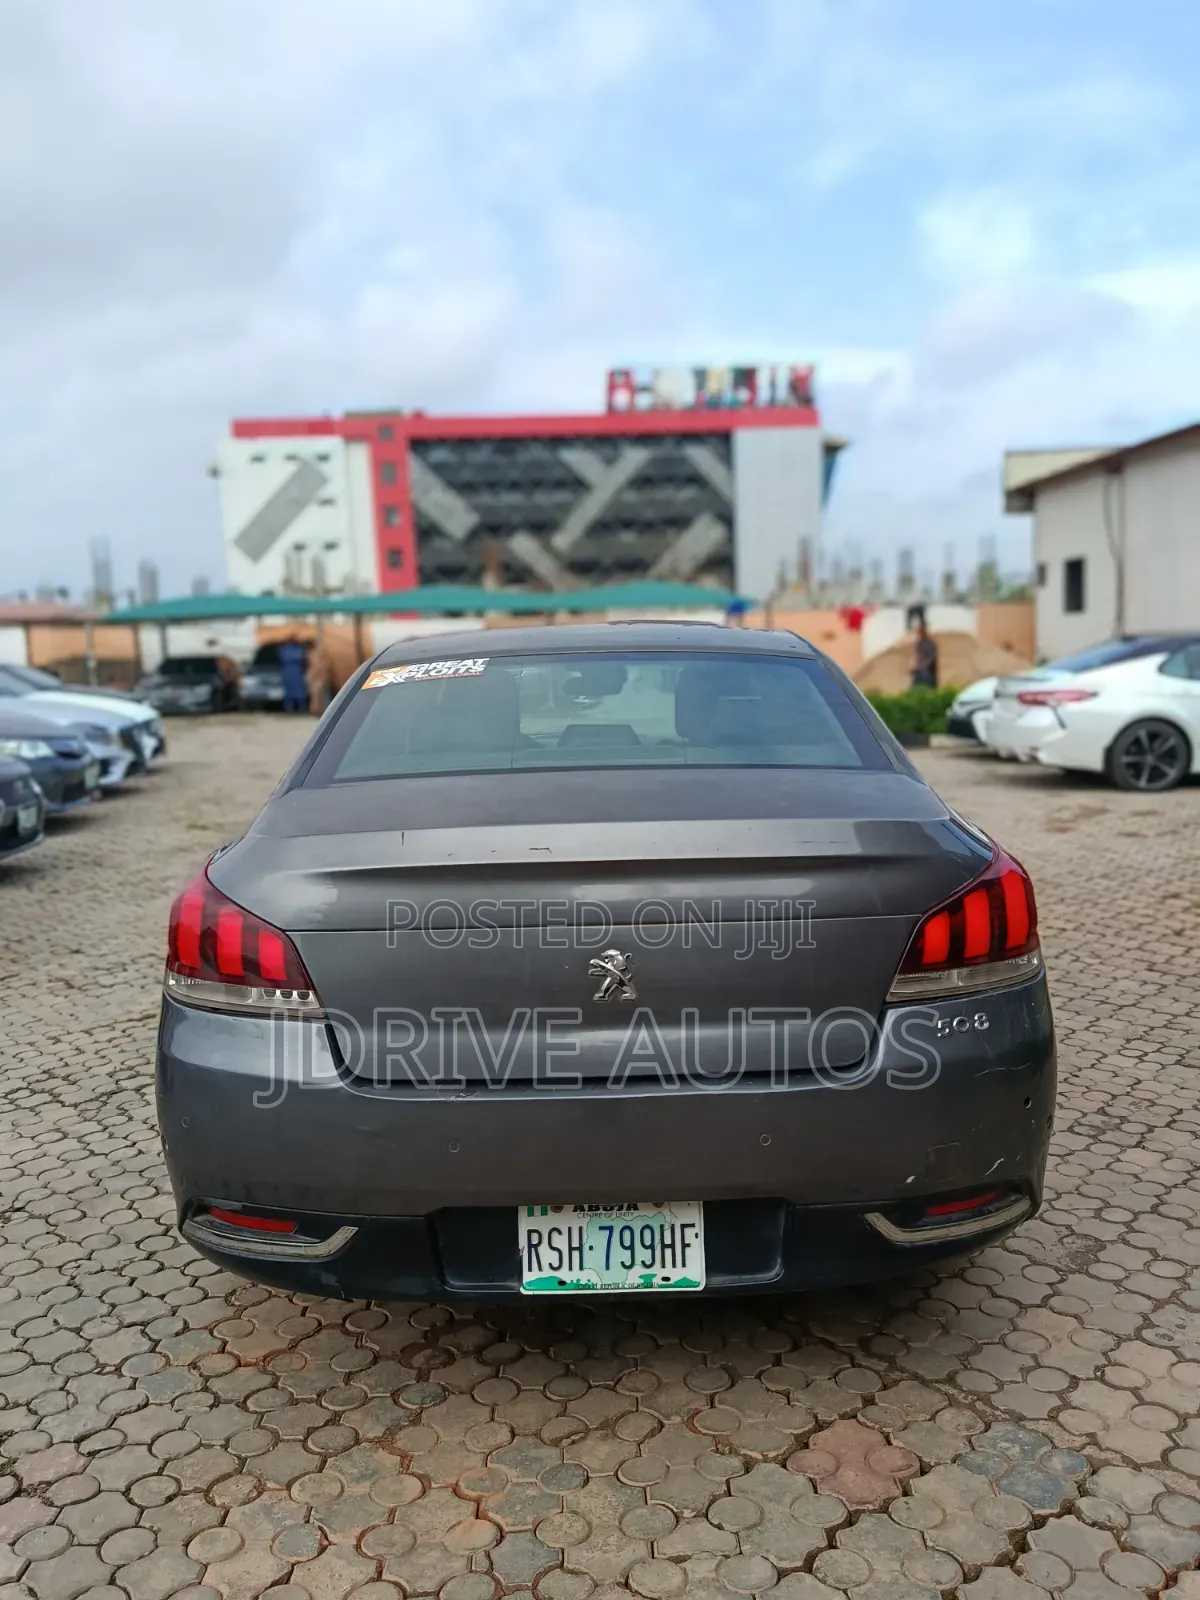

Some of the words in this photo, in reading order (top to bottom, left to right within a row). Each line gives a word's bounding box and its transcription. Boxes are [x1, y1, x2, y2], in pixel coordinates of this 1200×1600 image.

[411, 658, 490, 671] GREAT
[937, 1012, 990, 1037] 508
[572, 1203, 640, 1213] ABUJA
[577, 1211, 604, 1219] CENTRE
[615, 1210, 635, 1218] UNITY
